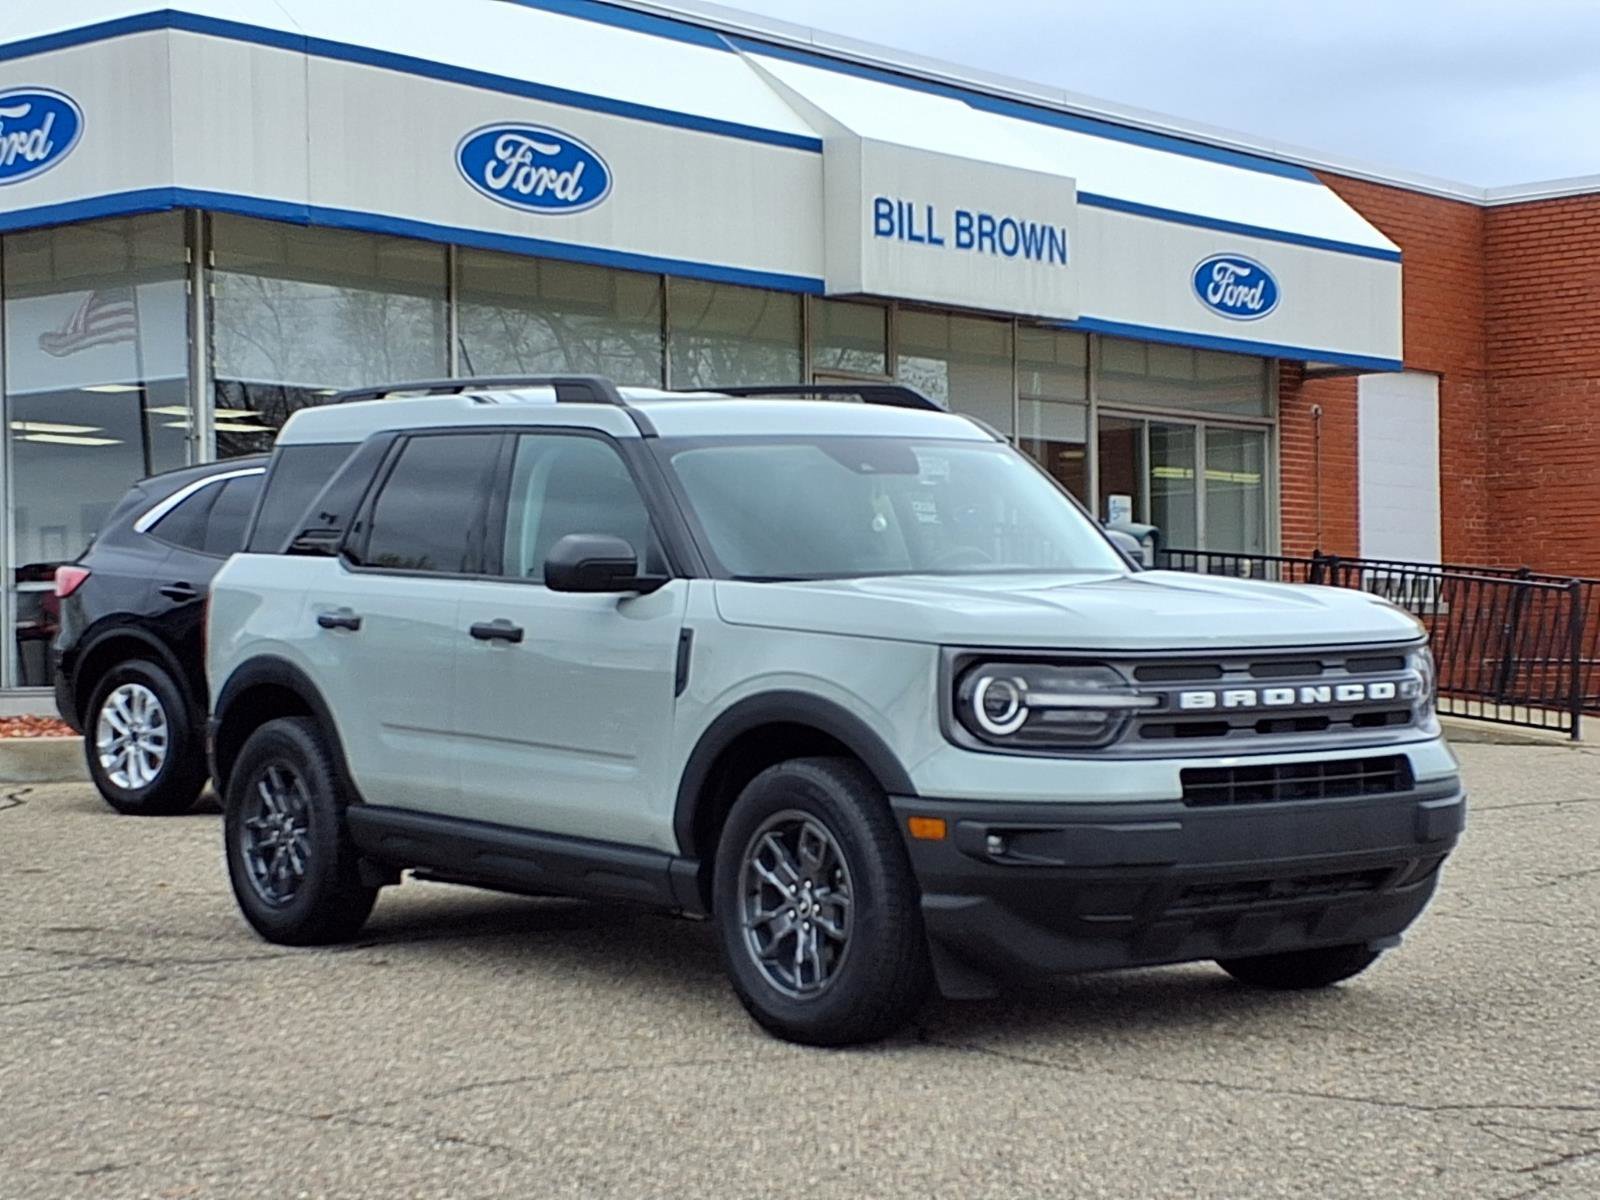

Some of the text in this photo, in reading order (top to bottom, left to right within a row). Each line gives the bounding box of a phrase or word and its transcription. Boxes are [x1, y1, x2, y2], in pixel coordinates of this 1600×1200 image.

[485, 133, 585, 202] Ford
[874, 197, 1067, 265] BILL BROWN
[1206, 262, 1265, 310] Ford
[1180, 682, 1396, 709] BRONCO
